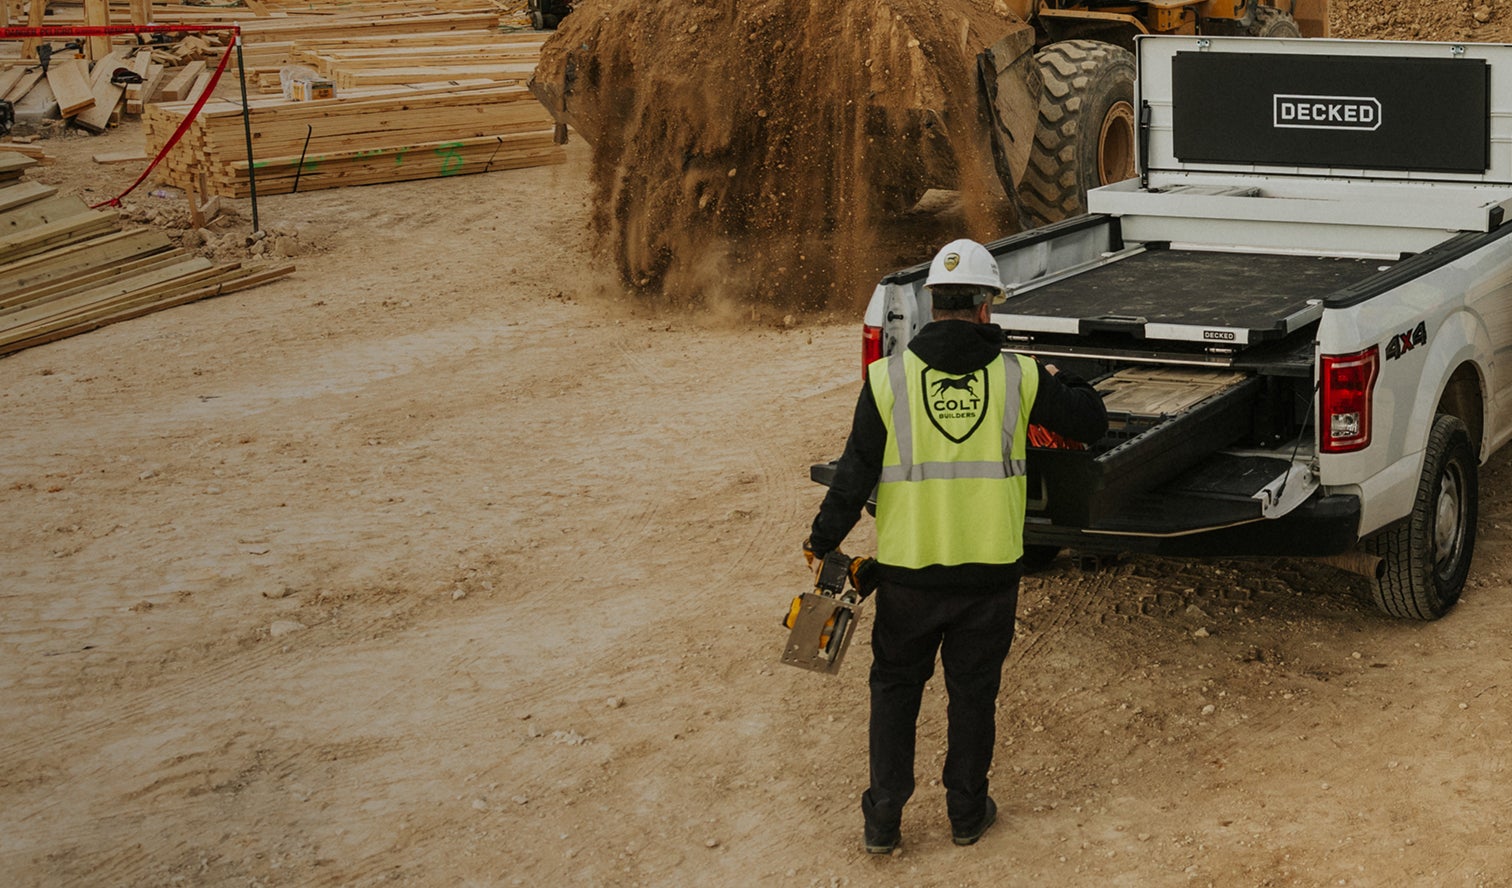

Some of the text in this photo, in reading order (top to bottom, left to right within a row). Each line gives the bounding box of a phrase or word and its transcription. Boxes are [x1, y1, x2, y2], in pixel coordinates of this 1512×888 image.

[1281, 103, 1374, 122] DECKED
[1205, 331, 1234, 340] DECKED
[934, 399, 980, 411] COLT
